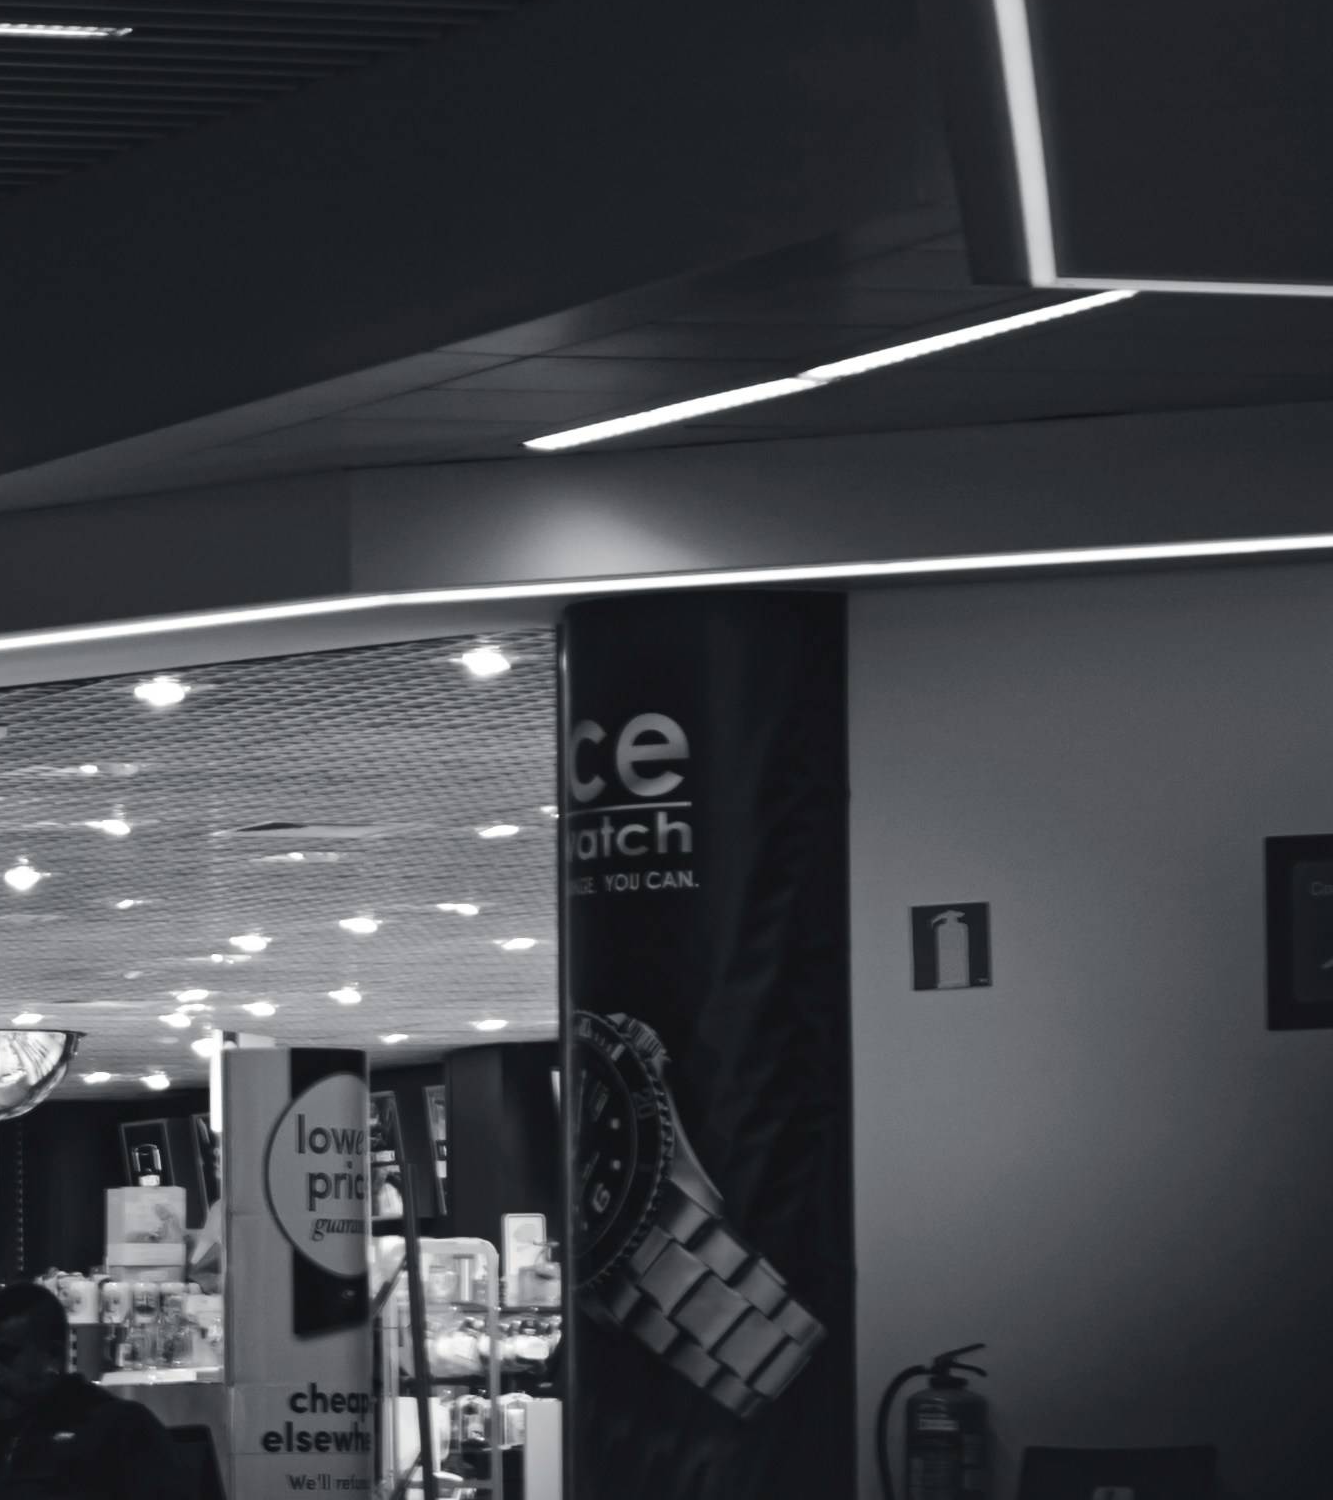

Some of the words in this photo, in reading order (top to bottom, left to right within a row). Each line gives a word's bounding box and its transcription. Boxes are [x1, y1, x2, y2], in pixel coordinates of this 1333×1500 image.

[605, 872, 640, 891] YOU
[646, 870, 700, 889] CAN.
[286, 1474, 331, 1490] We'll
